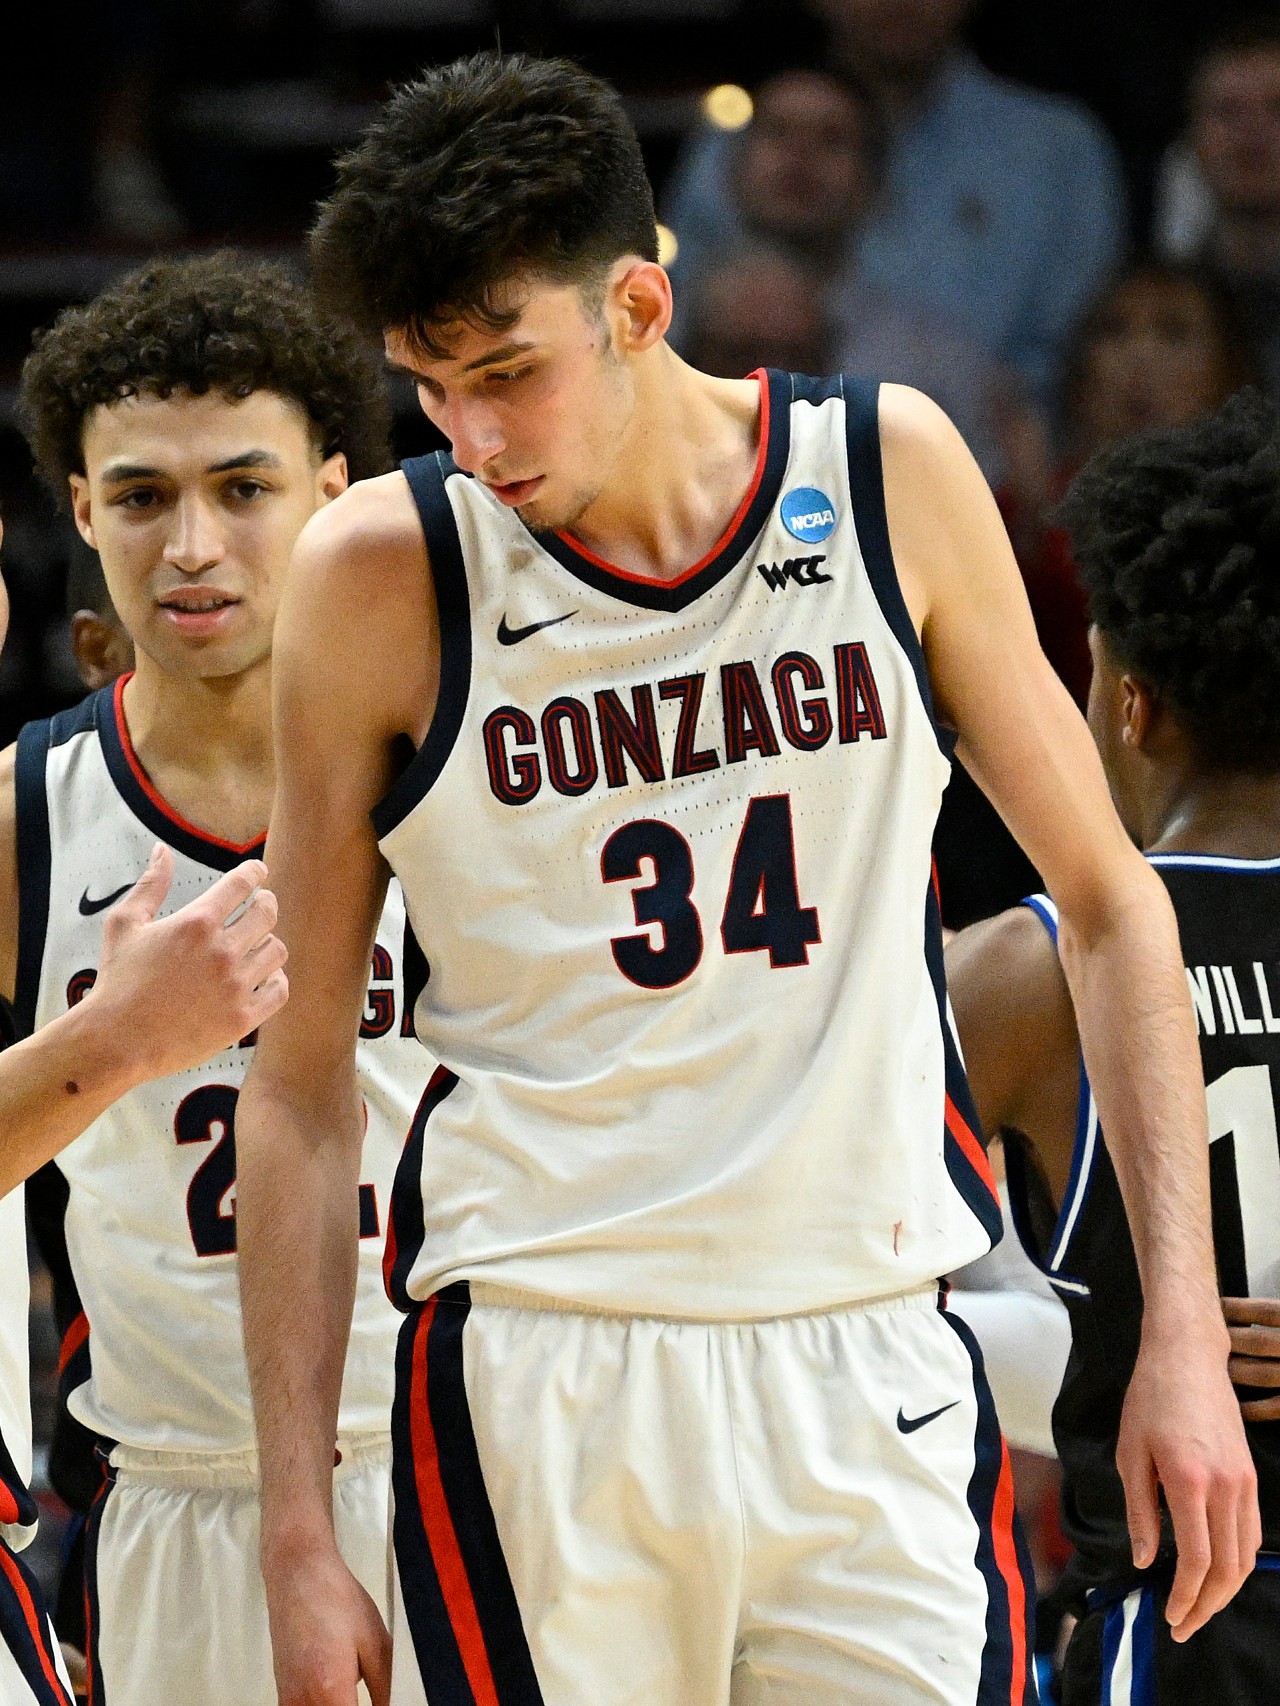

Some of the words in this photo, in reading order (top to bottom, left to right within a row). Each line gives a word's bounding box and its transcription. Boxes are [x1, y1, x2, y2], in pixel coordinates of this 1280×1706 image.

[790, 510, 834, 531] NCAA
[757, 555, 834, 592] WCC
[482, 641, 888, 806] GONZAGA
[600, 793, 822, 990] 34
